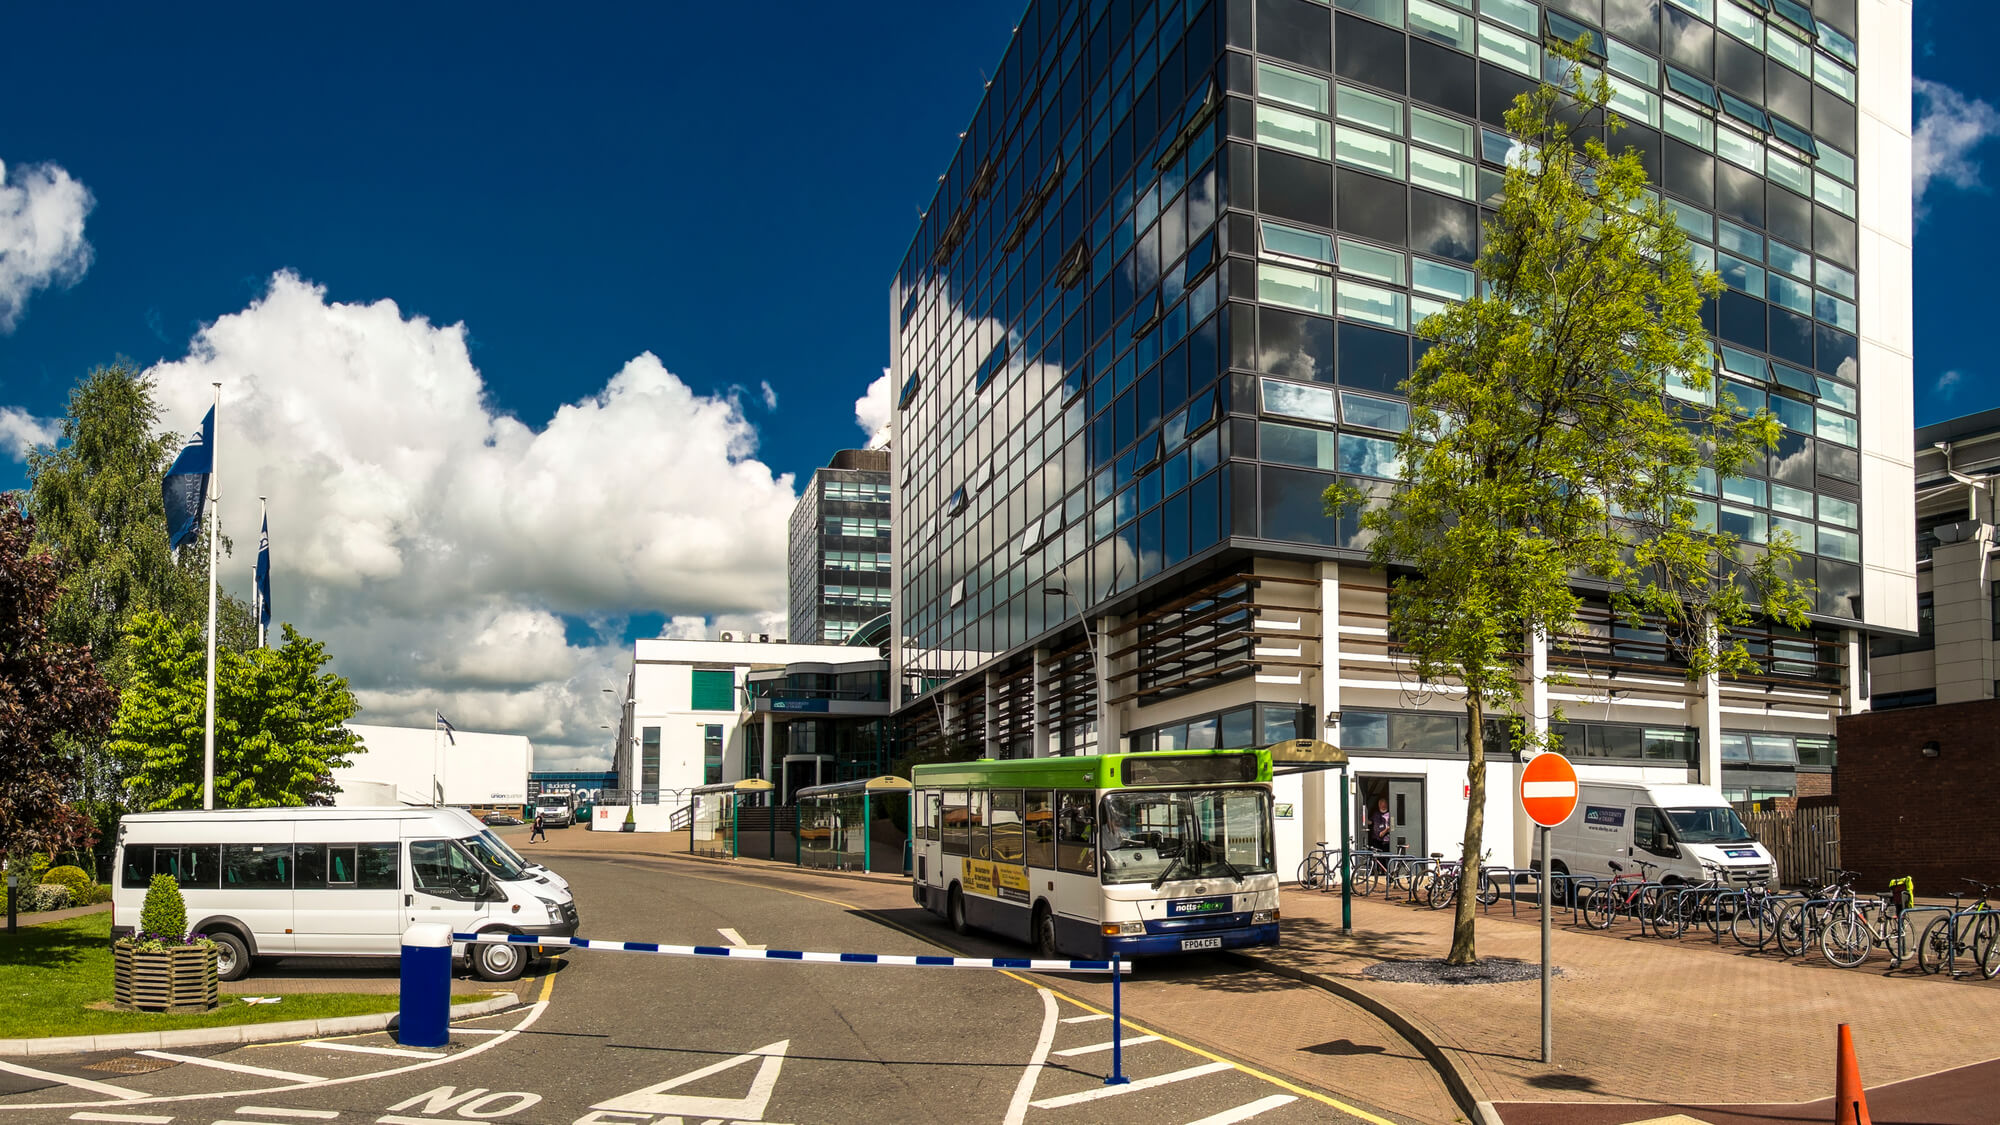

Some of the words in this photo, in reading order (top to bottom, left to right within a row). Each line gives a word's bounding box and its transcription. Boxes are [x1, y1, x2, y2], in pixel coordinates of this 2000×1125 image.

[1184, 941, 1203, 949] FP04
[1204, 939, 1219, 947] CFE
[386, 1085, 543, 1118] NO
